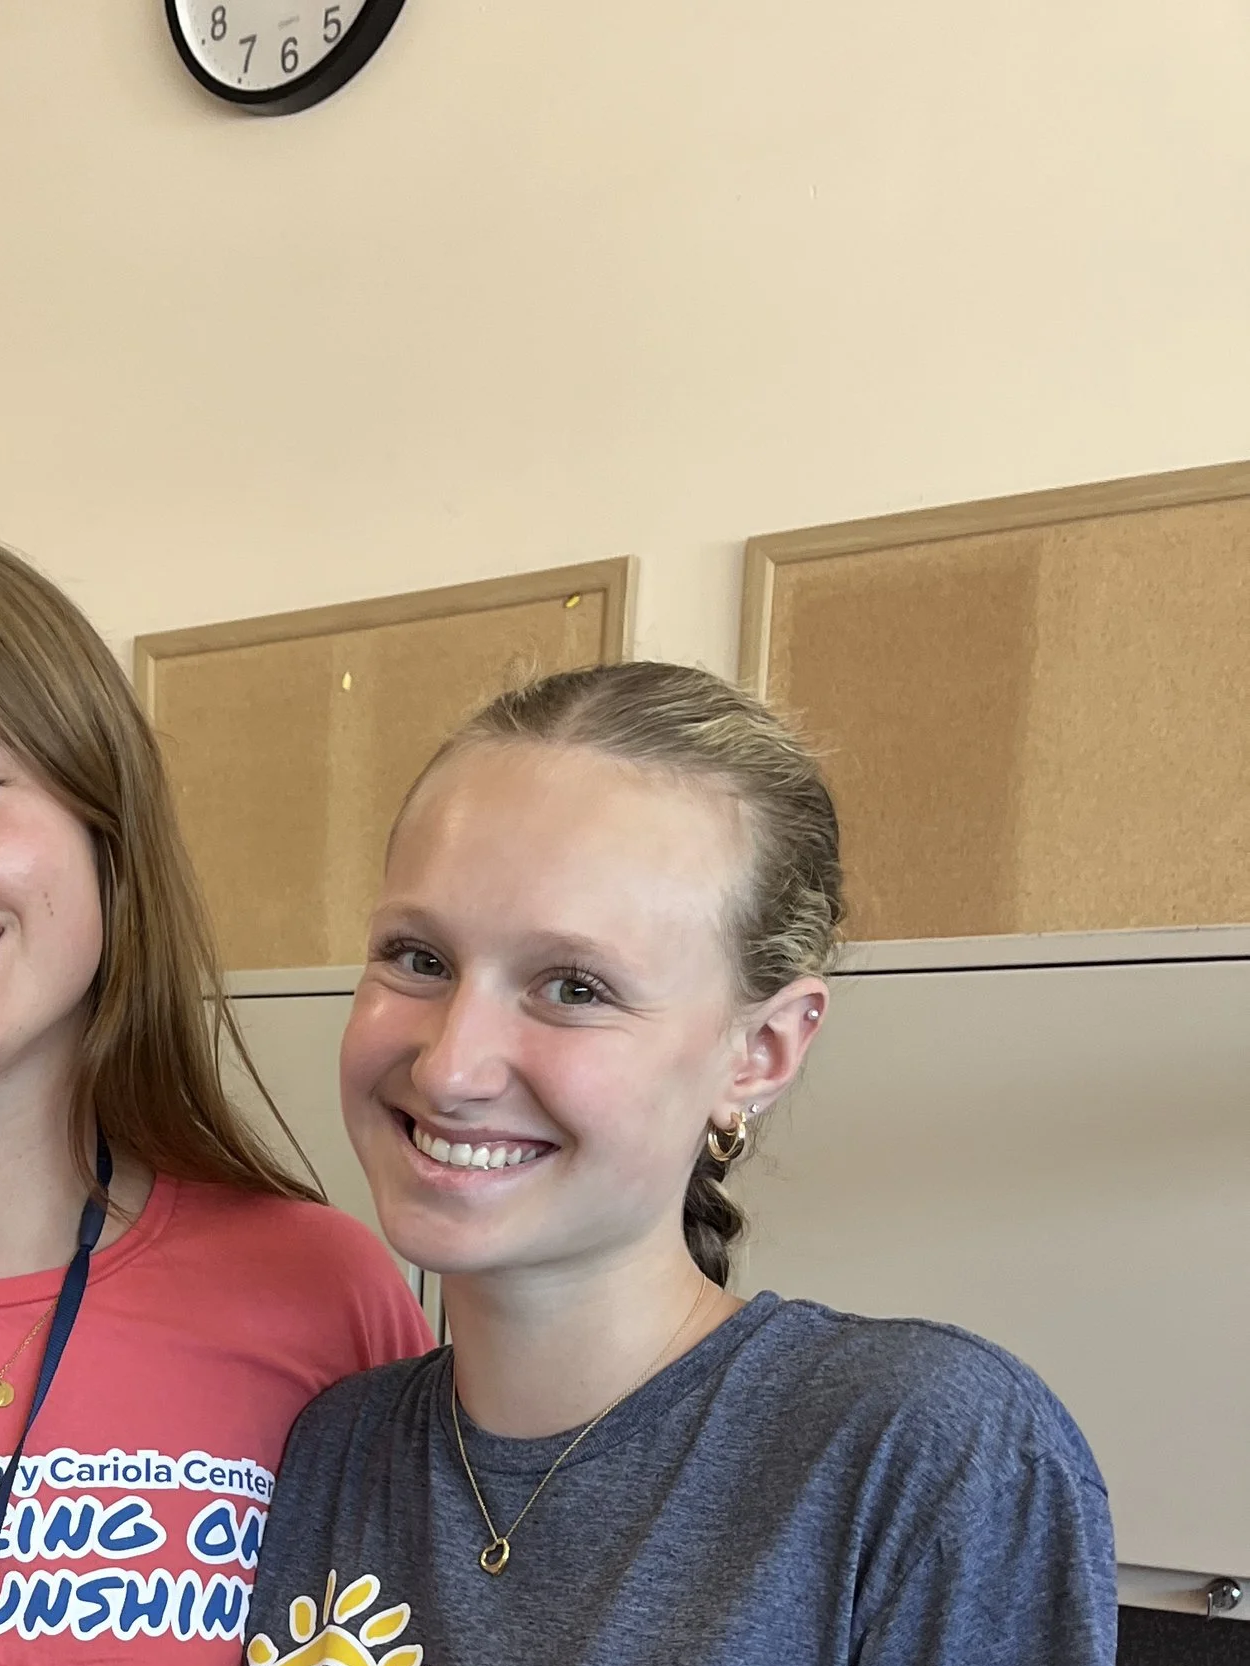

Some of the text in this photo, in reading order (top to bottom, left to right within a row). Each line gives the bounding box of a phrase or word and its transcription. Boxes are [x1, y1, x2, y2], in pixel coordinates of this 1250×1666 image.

[210, 6, 227, 41] 8
[323, 5, 342, 43] 5
[239, 34, 258, 74] 7
[280, 37, 298, 73] 6
[50, 1456, 173, 1484] Cariola
[183, 1459, 275, 1498] Center
